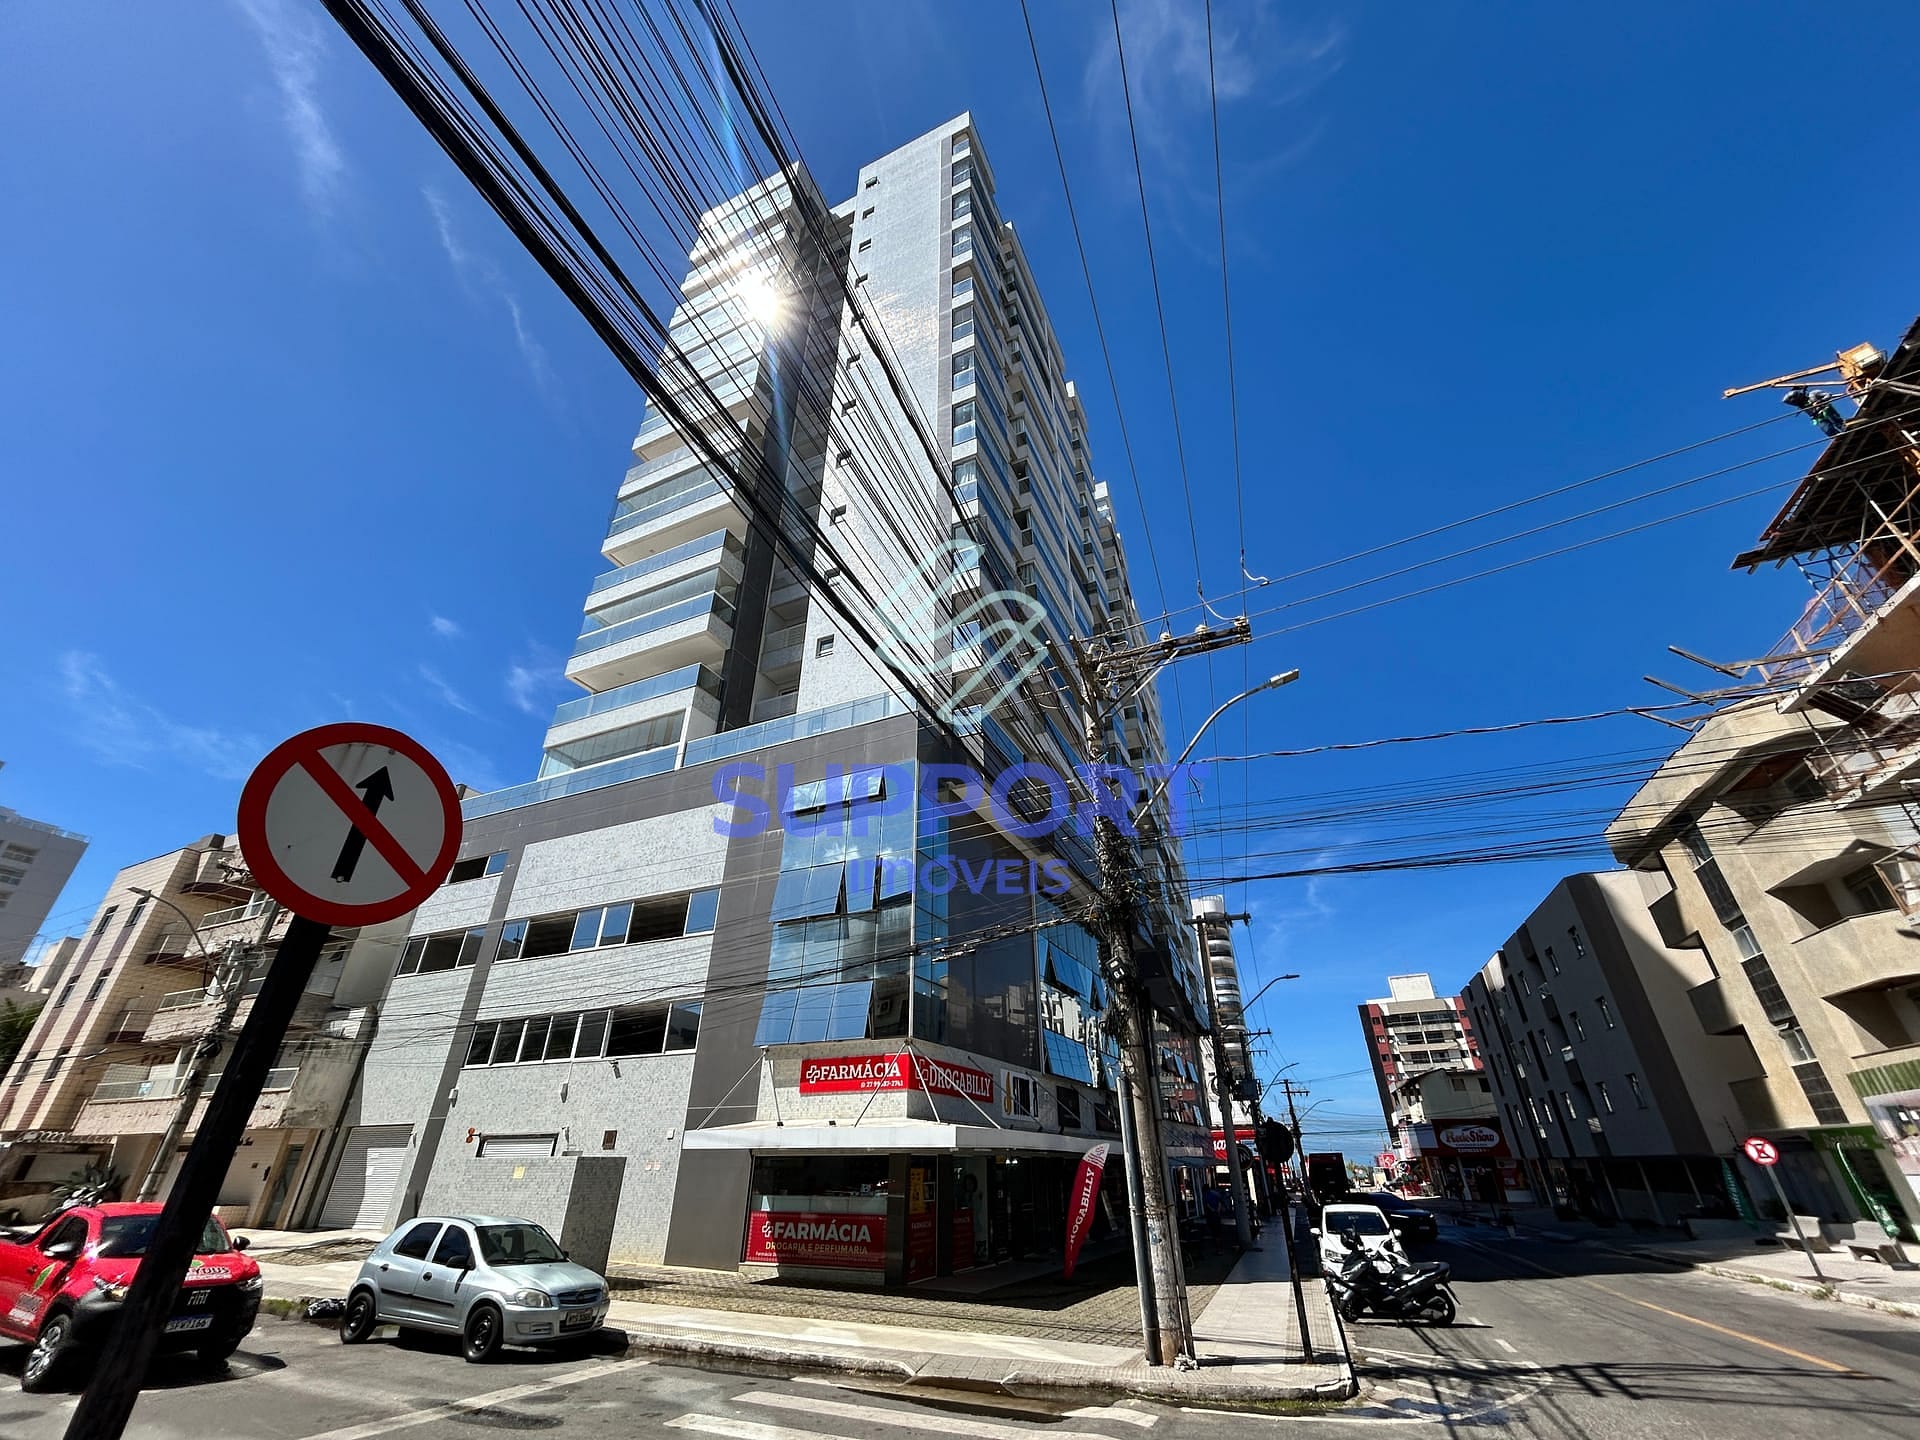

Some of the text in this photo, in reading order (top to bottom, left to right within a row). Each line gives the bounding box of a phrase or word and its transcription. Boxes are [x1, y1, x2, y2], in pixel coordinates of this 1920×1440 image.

[820, 1059, 902, 1081] FARMÁCIA
[928, 1065, 992, 1098] DROGABILLY
[773, 1220, 871, 1243] FARMÁCIA
[765, 1241, 806, 1251] DROGARIA
[814, 1244, 868, 1255] PERFUMARIA
